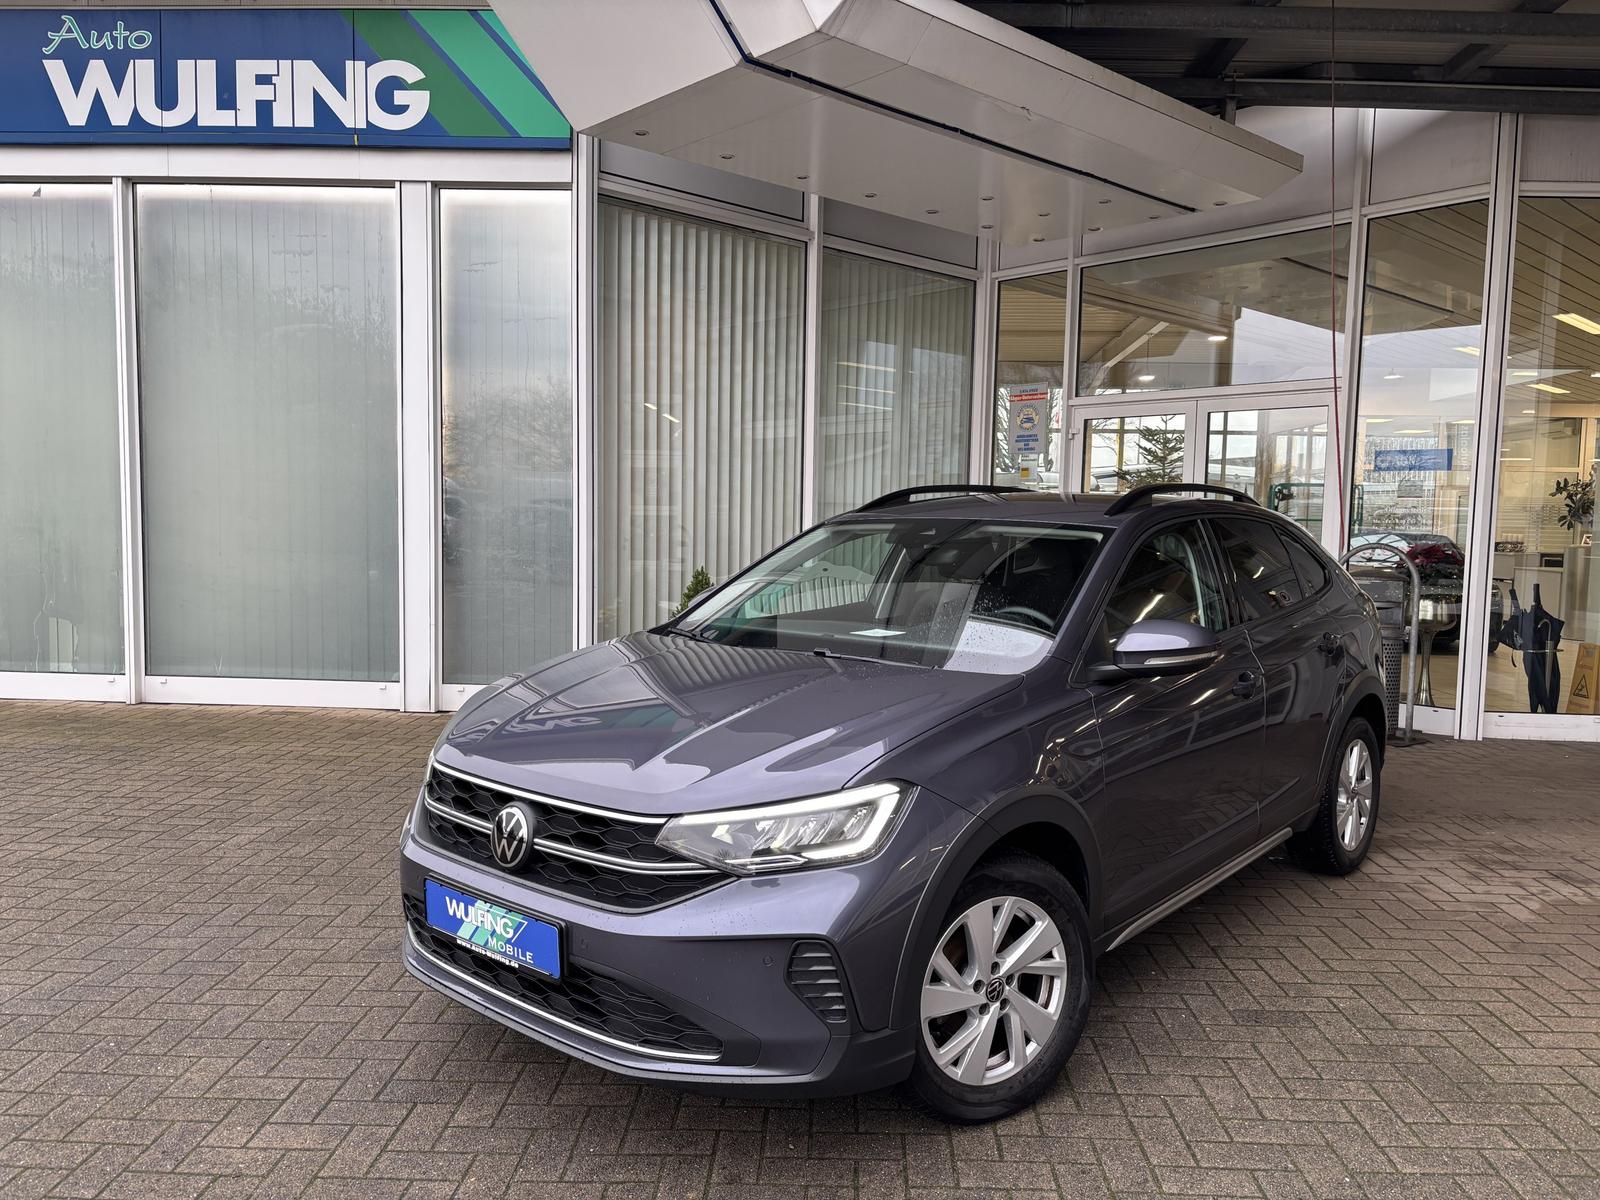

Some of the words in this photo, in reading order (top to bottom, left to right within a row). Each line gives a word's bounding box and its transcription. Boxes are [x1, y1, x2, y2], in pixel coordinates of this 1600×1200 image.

[43, 15, 152, 54] Auto
[42, 59, 430, 131] WULFING
[445, 896, 514, 939] WULFING
[488, 935, 534, 964] MOBILE
